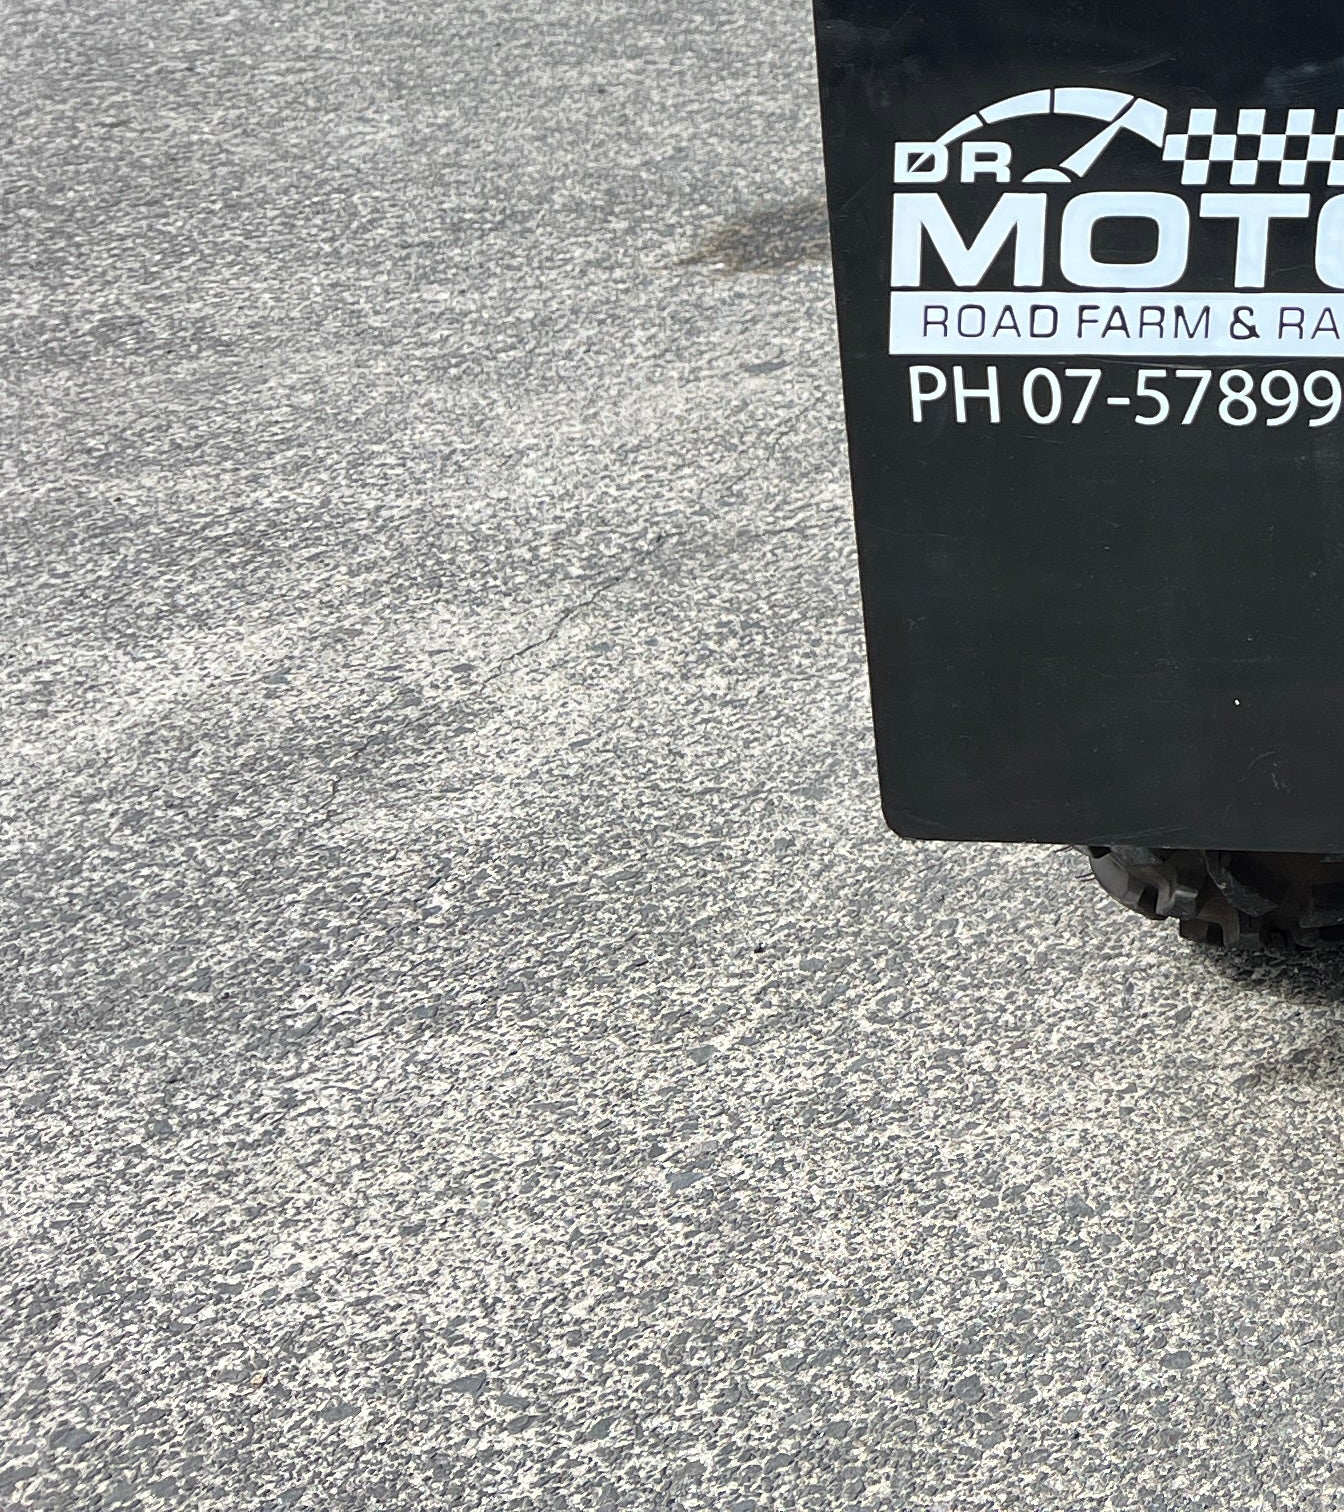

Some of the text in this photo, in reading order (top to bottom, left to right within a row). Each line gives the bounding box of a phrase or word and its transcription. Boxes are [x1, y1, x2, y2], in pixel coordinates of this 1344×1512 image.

[893, 141, 1013, 183] DR
[923, 304, 1058, 339] ROAD
[1077, 304, 1211, 339] FARM
[1229, 305, 1261, 340] &
[908, 365, 1001, 424] PH
